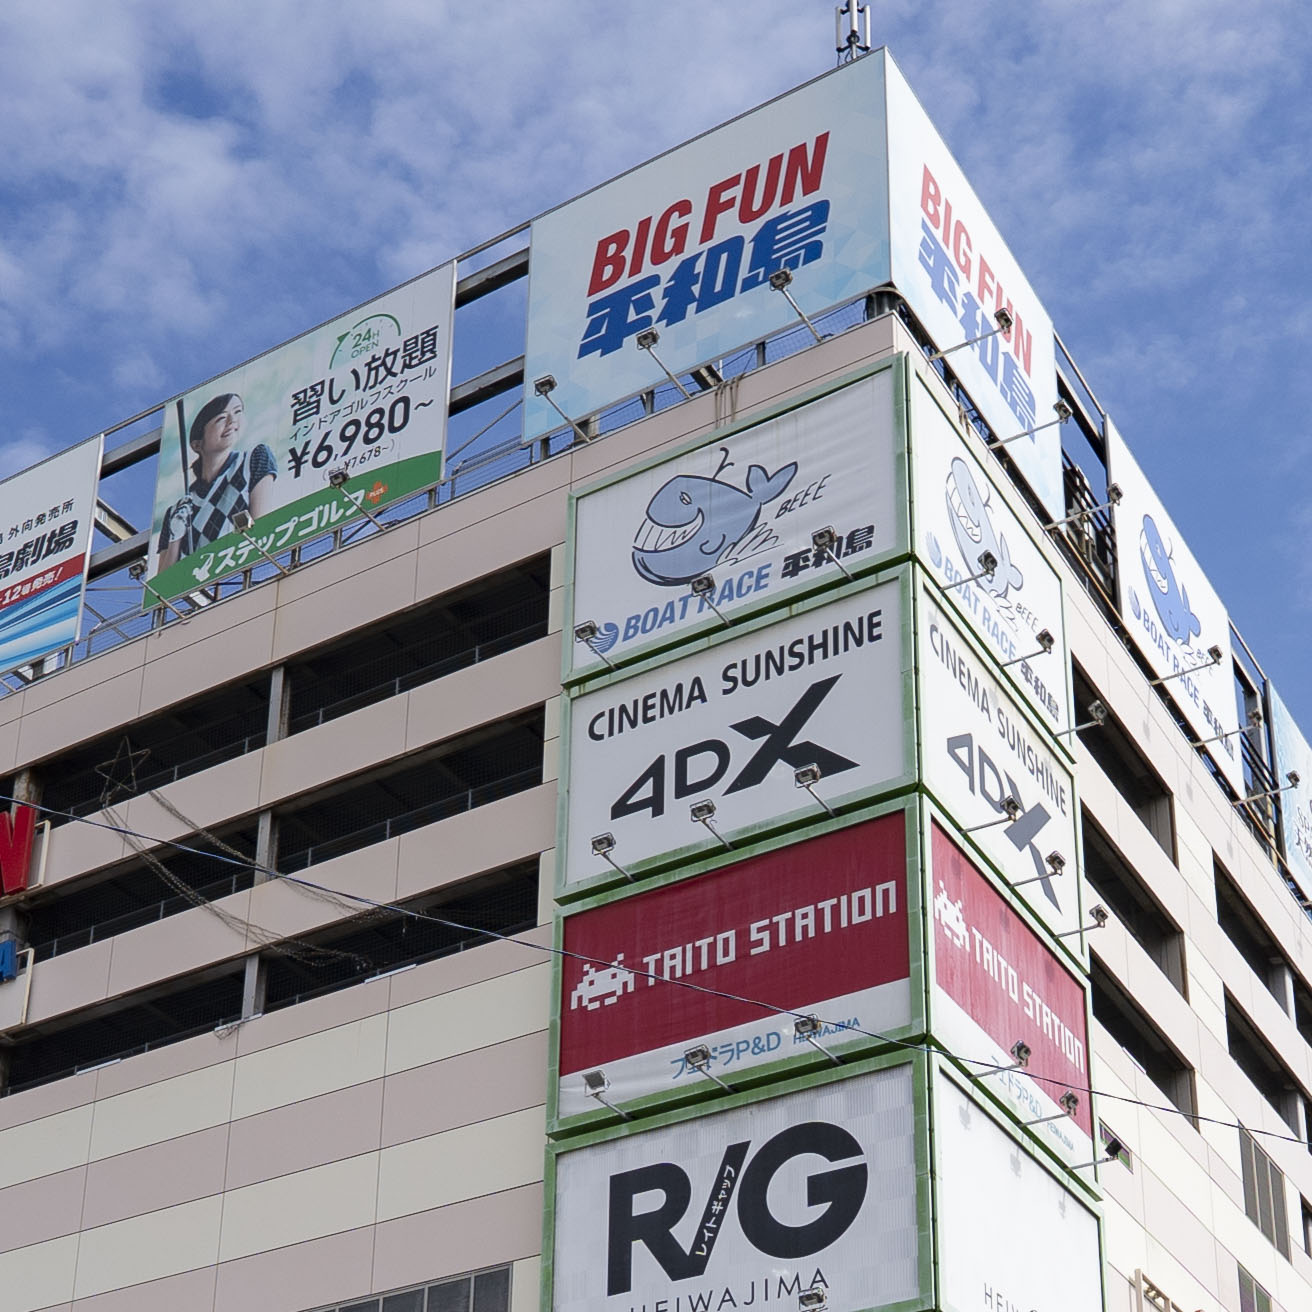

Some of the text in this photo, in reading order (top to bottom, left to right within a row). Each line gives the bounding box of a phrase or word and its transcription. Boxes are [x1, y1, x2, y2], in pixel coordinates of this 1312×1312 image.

[587, 130, 831, 298] BIG FUN
[577, 199, 831, 359] 平和島
[920, 163, 1032, 379] BIG FUN
[290, 325, 439, 426] 習い放題
[350, 339, 379, 359] OPEN
[918, 218, 1037, 442] 平和島
[290, 365, 437, 441] インドアゴルフスクール
[7, 498, 75, 539] 外向発売所
[214, 488, 367, 575] ステップゴルフ
[622, 592, 691, 643] BOAT
[943, 555, 1016, 661] BOAT RACE
[1143, 609, 1200, 708] BOAT RACE
[588, 609, 884, 742] CINEMA SUNSHINE
[929, 624, 1067, 817] CINEMA SUNSHINE
[1021, 657, 1059, 722] 平和島
[609, 673, 861, 820] 4DX
[946, 733, 1063, 915] 4DX
[643, 880, 897, 986] TAITO STATION
[971, 926, 1085, 1075] TAITO STATION
[695, 1165, 735, 1257] レイトギャップ
